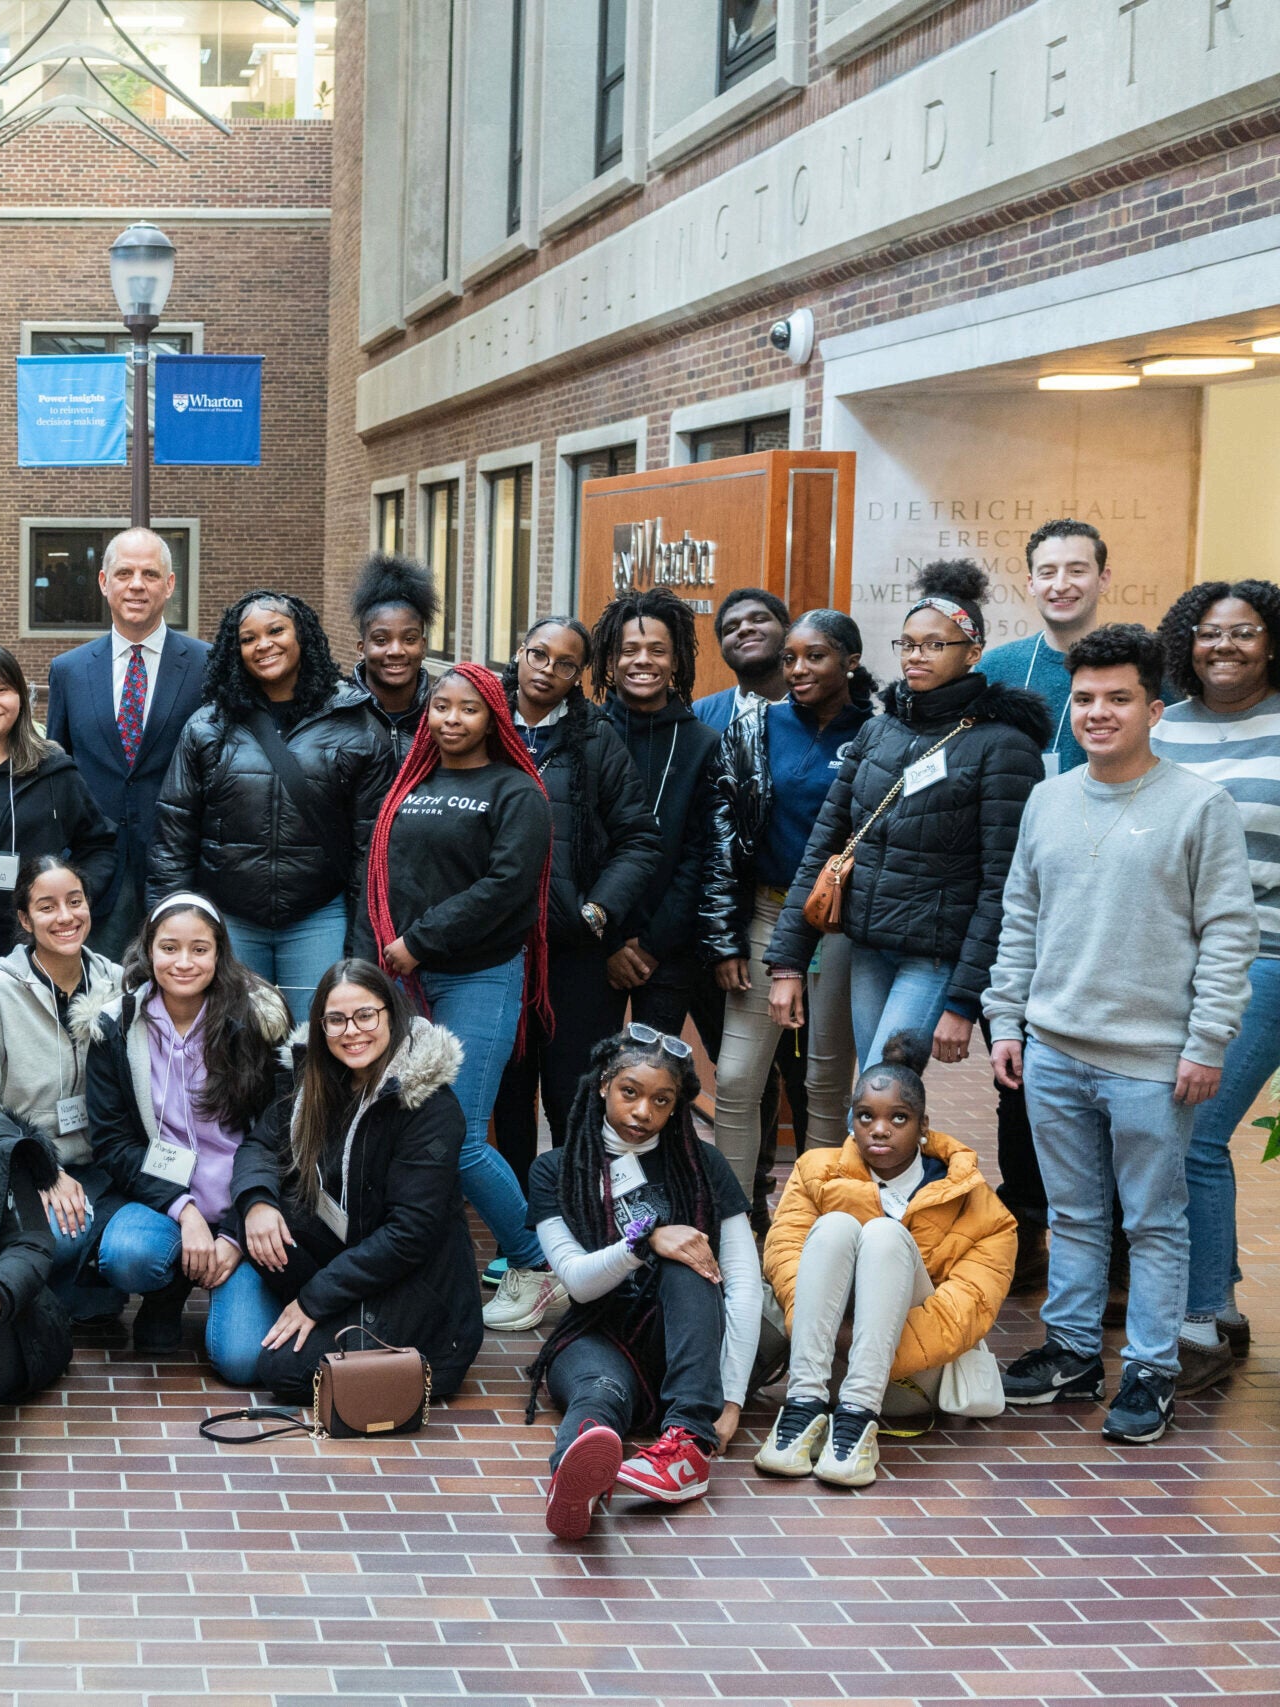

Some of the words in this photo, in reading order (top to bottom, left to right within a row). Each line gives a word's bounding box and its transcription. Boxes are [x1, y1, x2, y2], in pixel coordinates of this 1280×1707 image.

[38, 394, 68, 403] Power
[69, 394, 106, 404] insights
[189, 393, 243, 408] Wharton
[50, 406, 58, 414] to
[59, 405, 94, 414] reinvent
[868, 500, 1034, 521] DIETRICH
[1061, 499, 1148, 520] HALL
[938, 530, 1028, 548] ERECT
[896, 557, 921, 574] IN
[983, 619, 1029, 638] 950
[402, 794, 443, 806] NETH
[447, 795, 490, 813] COLE
[421, 808, 443, 816] YORK
